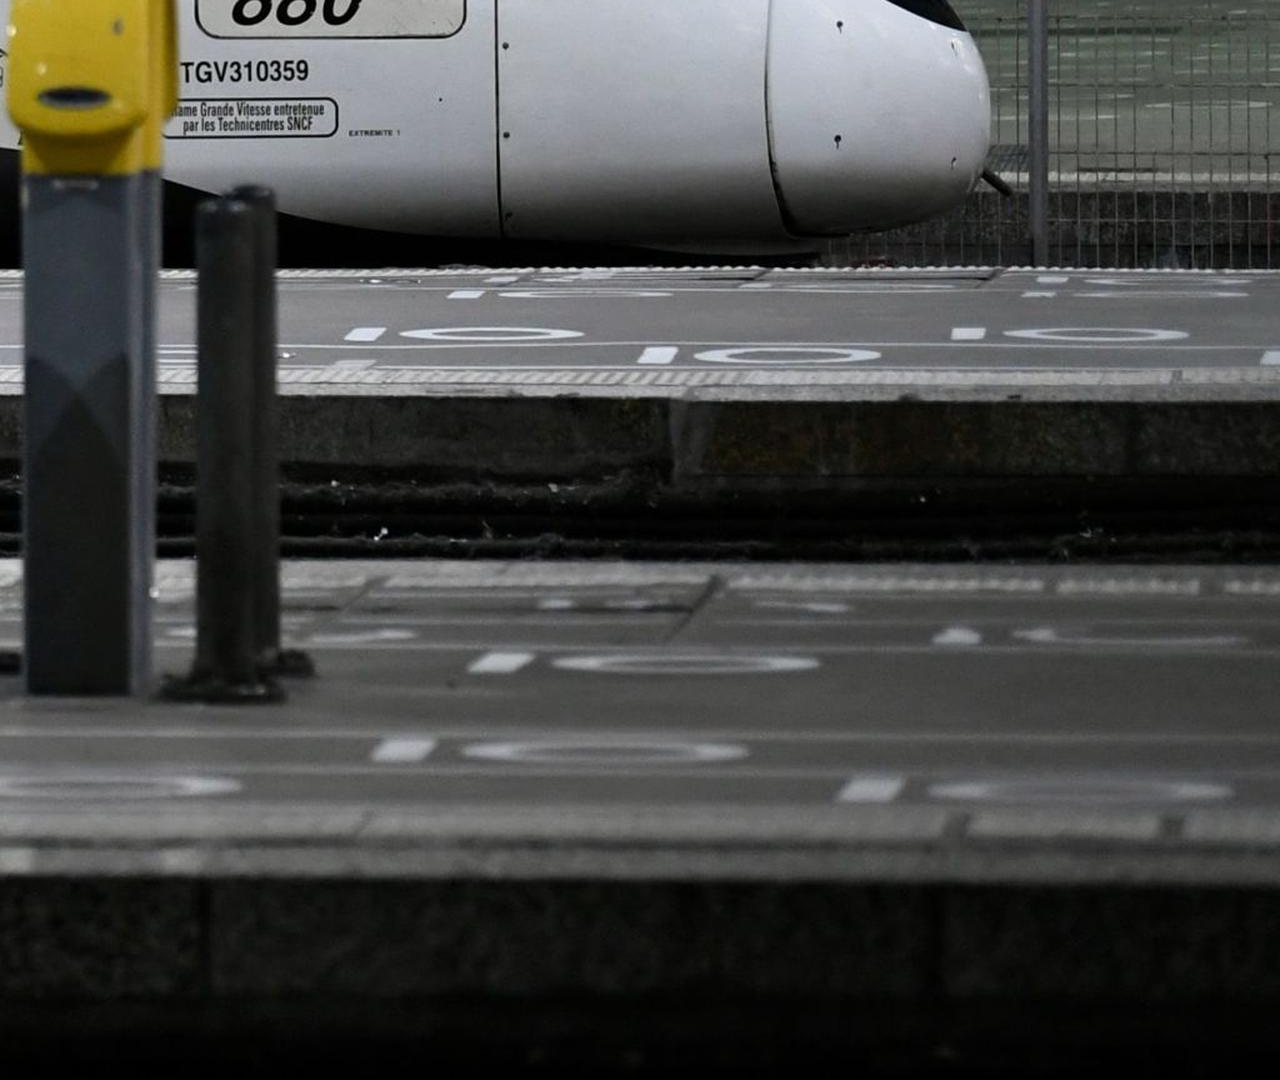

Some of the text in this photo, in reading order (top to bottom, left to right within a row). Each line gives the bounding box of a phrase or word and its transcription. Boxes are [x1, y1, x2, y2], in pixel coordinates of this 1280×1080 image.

[180, 58, 310, 83] TGV310359
[174, 100, 325, 117] ame Grande Vitesse entretenue
[182, 115, 313, 137] par les Technicentres SNCF
